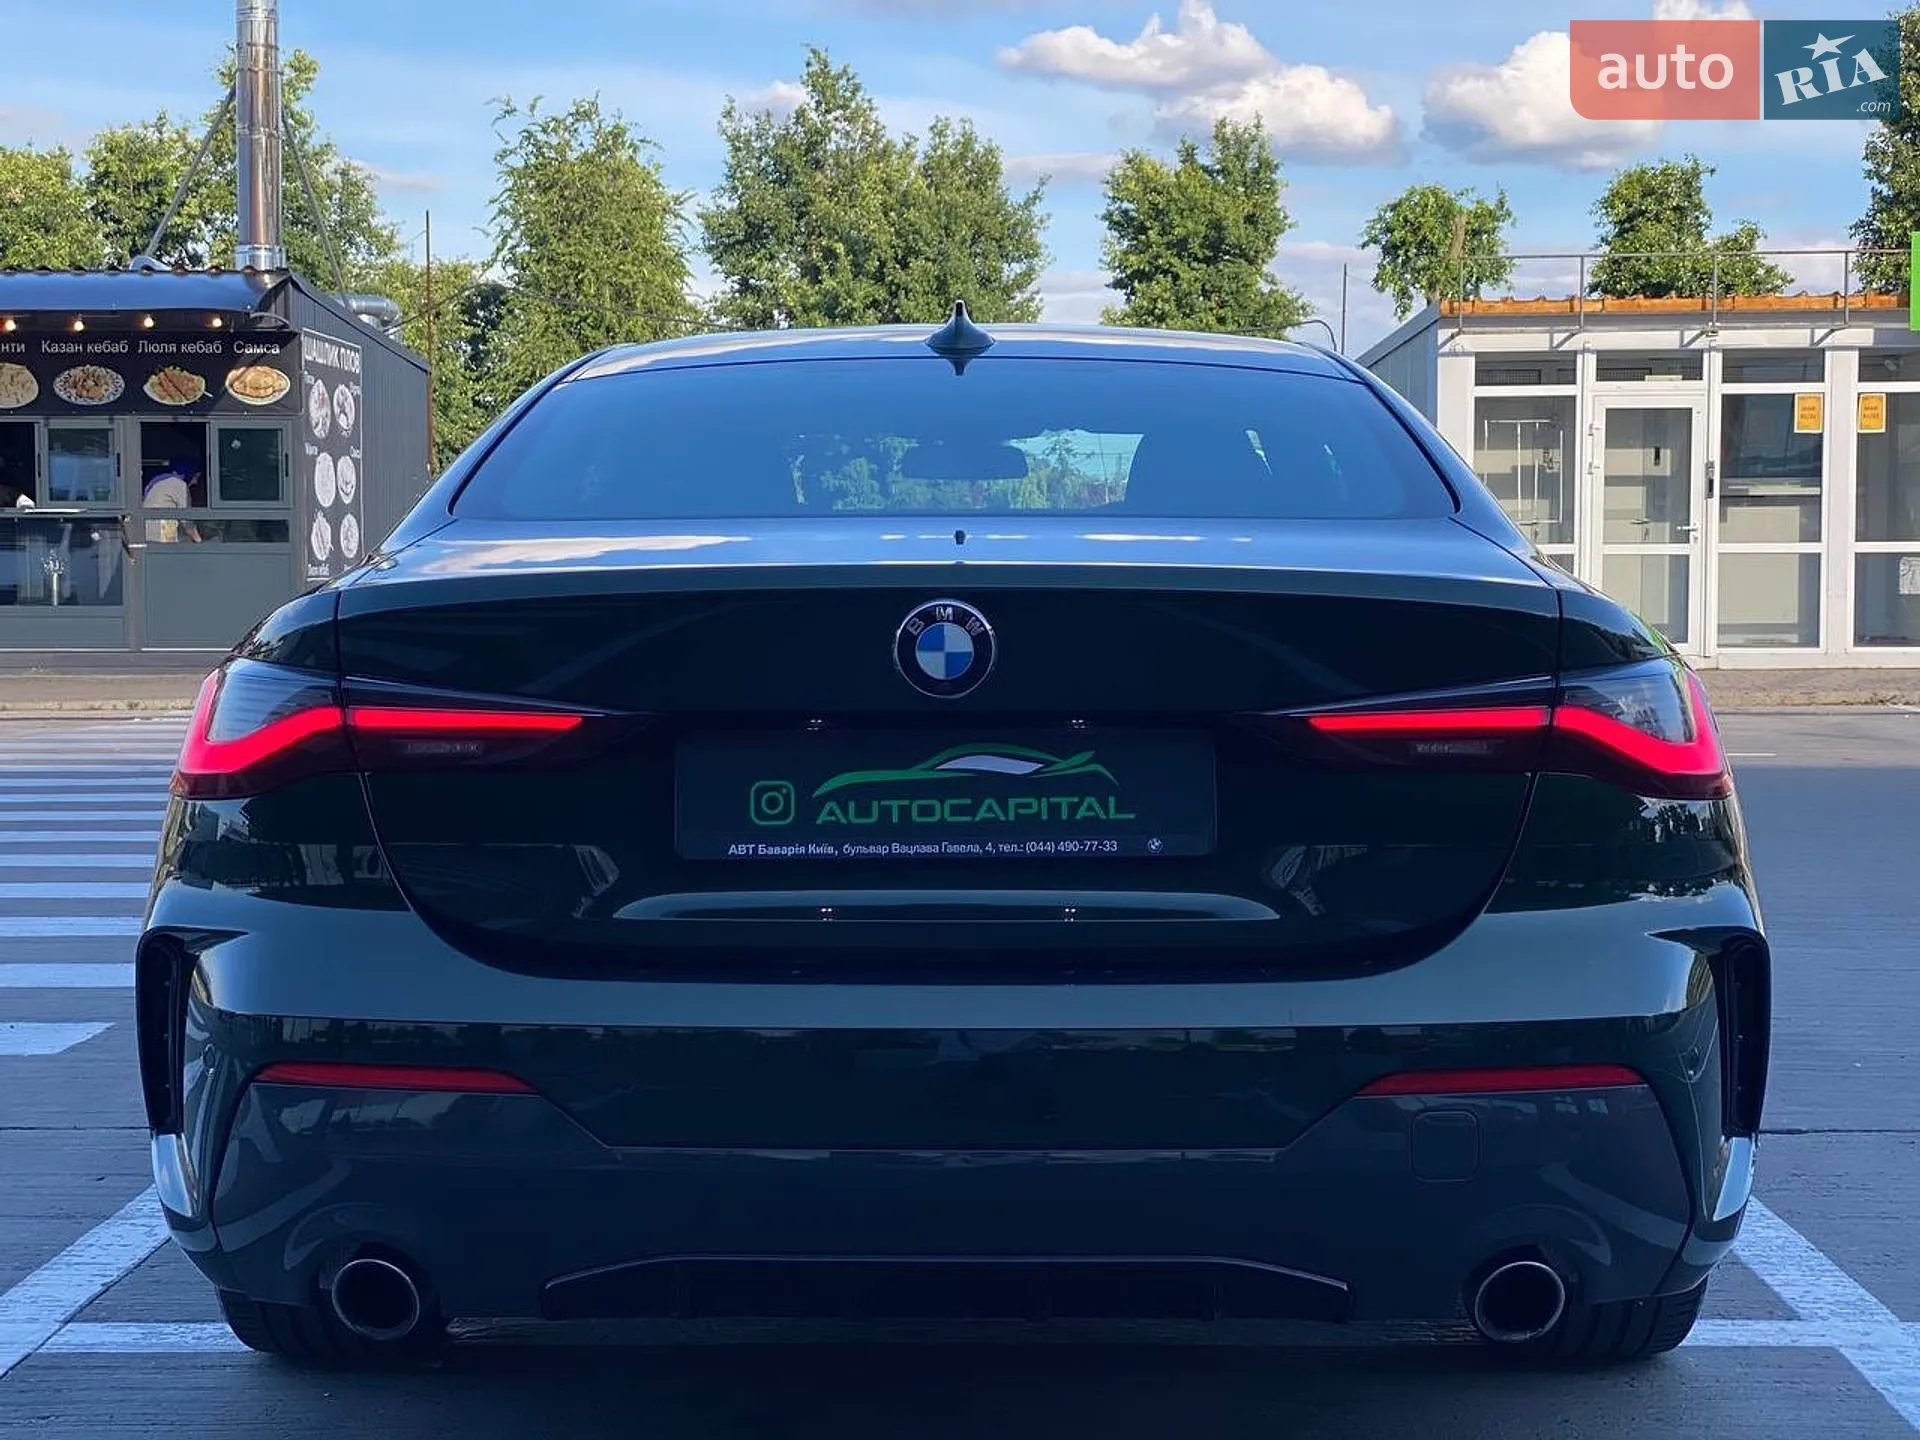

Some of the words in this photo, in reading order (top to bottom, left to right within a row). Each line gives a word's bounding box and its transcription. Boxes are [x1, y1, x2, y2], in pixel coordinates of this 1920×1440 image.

[41, 340, 83, 353] Казан
[87, 340, 129, 353] кебаб
[138, 340, 177, 354] Люля
[181, 340, 222, 354] кебаб
[233, 340, 280, 354] Самса
[906, 605, 985, 637] BMW
[816, 796, 1136, 825] AUTOCAPITAL
[728, 843, 756, 856] АВТ
[757, 843, 806, 857] Баварія
[808, 842, 838, 856] Київ,
[842, 843, 889, 857] бульвар
[891, 842, 939, 855] Вацлава
[985, 841, 996, 854] 4,
[1025, 840, 1055, 853] (044)
[1057, 839, 1118, 852] 490-77-33
